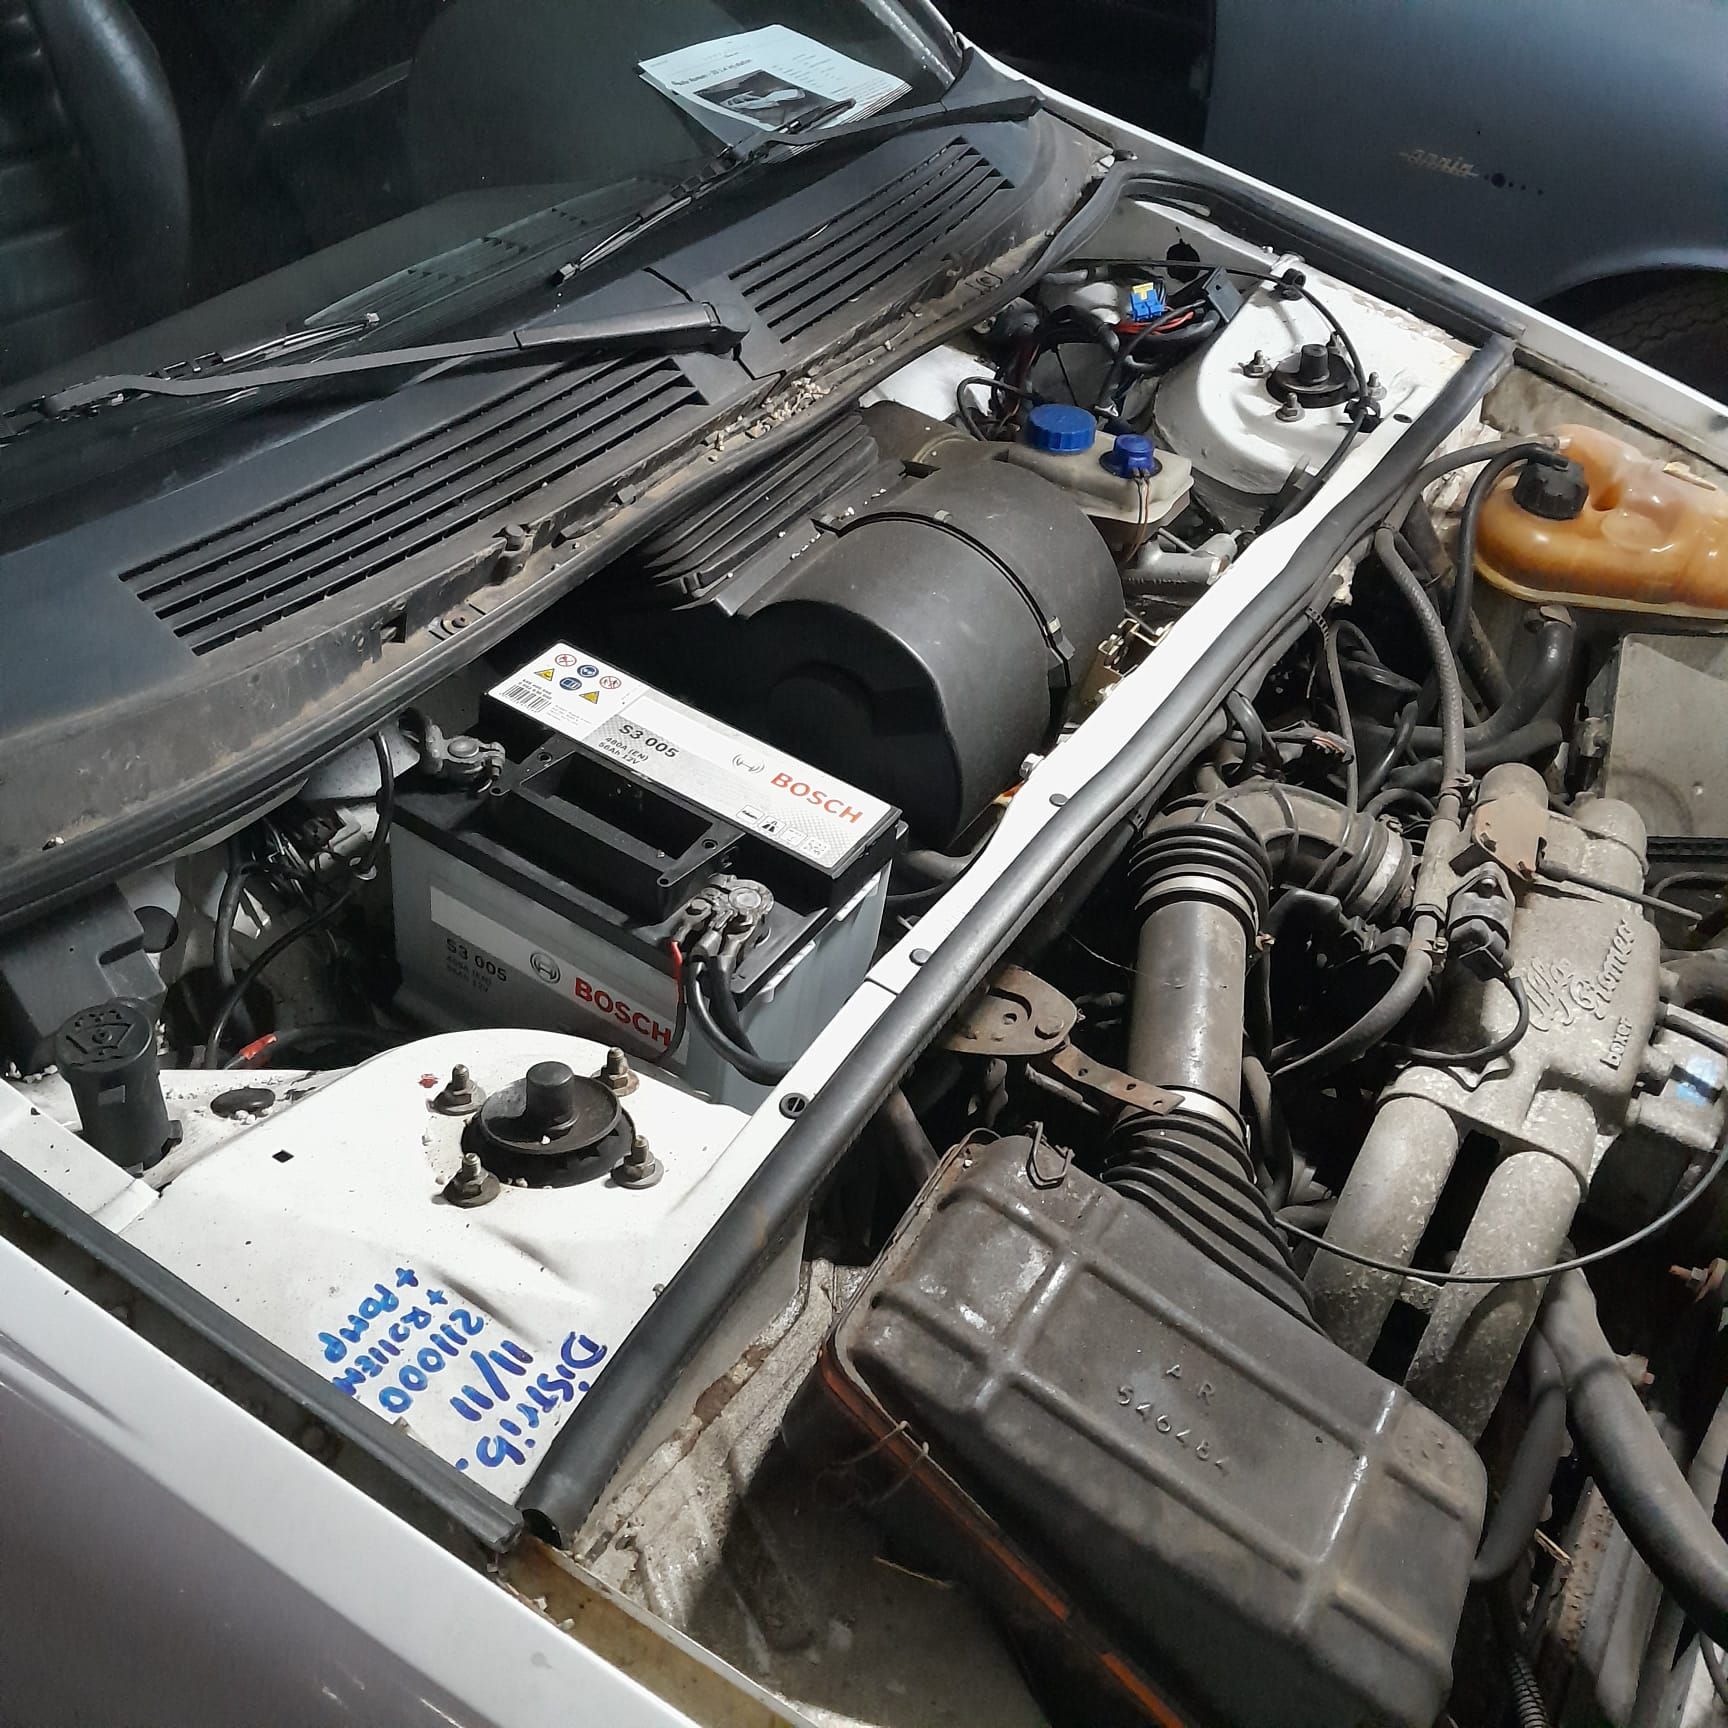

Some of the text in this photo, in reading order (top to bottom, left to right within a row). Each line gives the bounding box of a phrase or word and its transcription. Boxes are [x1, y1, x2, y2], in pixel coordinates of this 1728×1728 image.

[619, 724, 680, 758] S3 005
[621, 754, 641, 766] 12V
[628, 747, 649, 762] (EN)
[770, 772, 864, 823] BOSCH
[446, 938, 469, 961] S3
[474, 955, 507, 982] 005
[575, 976, 672, 1046] BOSCH
[1600, 1016, 1633, 1071] boxer
[395, 1267, 419, 1288] +
[426, 1289, 448, 1305] +
[378, 1309, 484, 1413] 211000
[450, 1340, 533, 1421] 11/11
